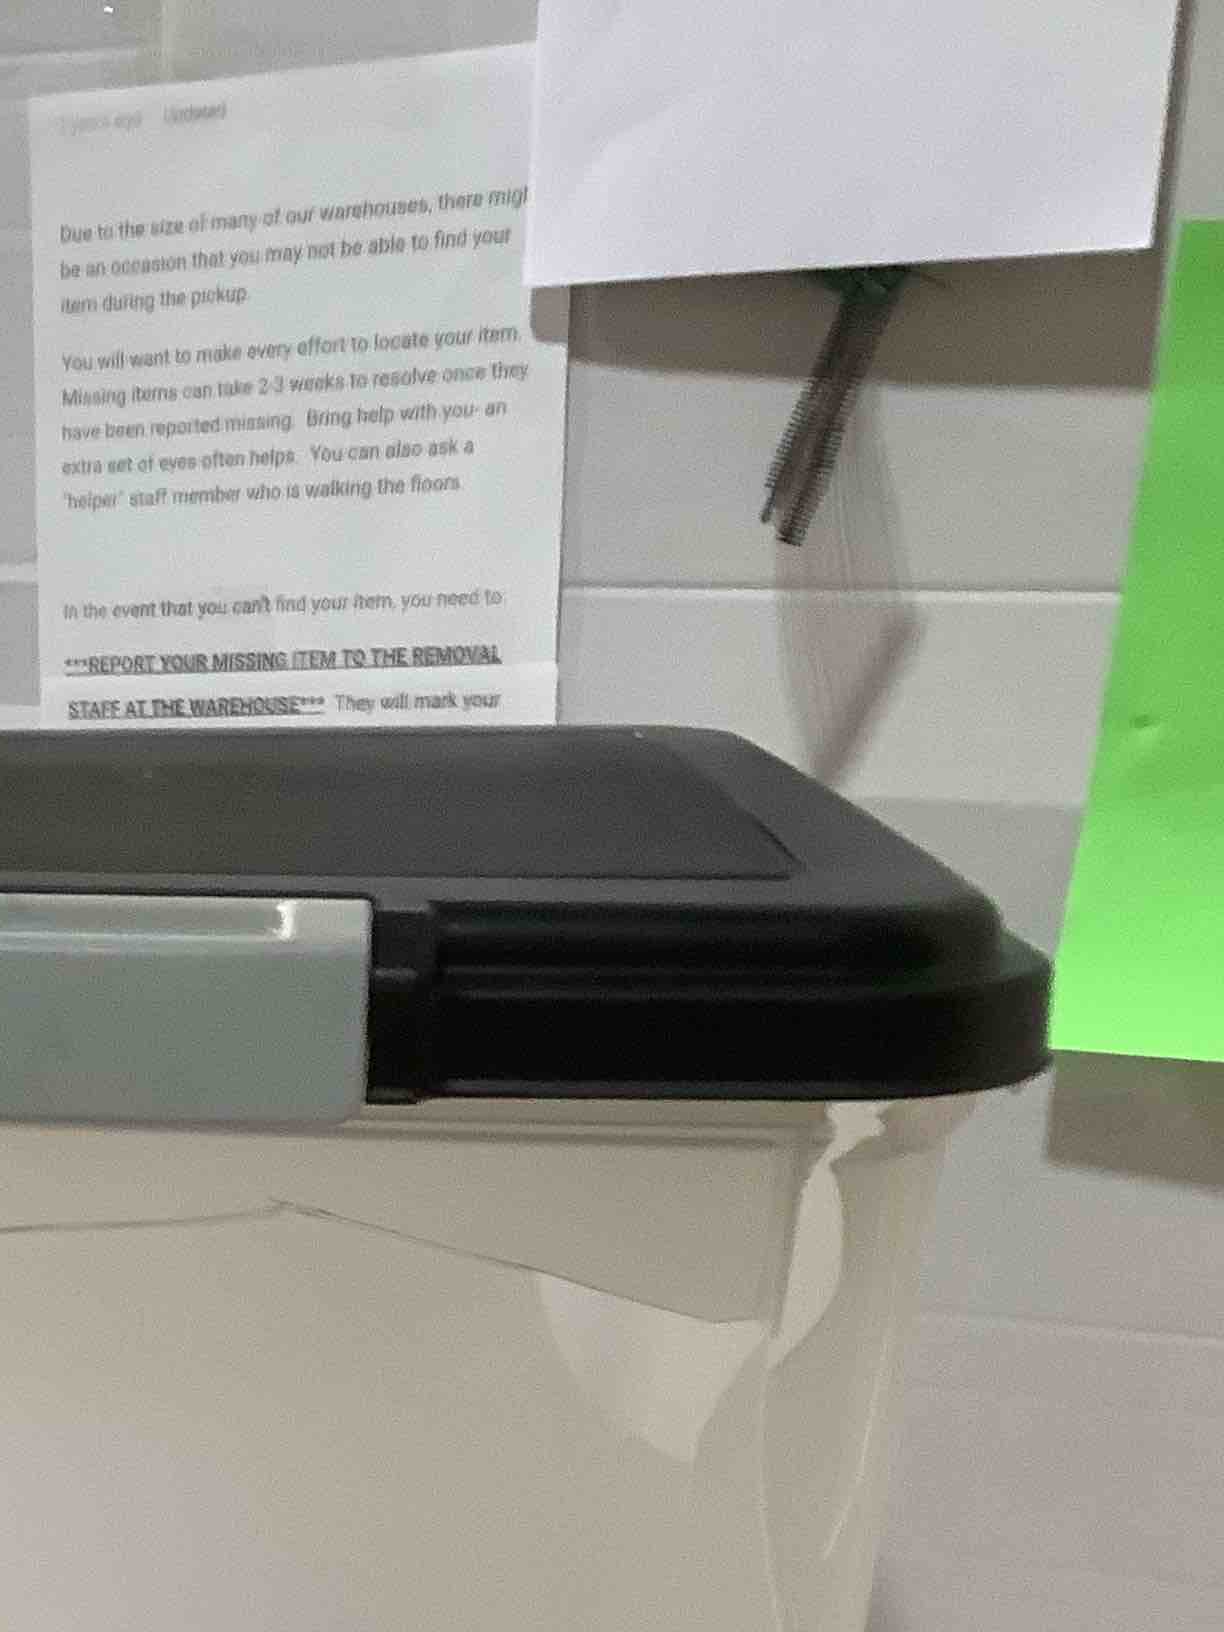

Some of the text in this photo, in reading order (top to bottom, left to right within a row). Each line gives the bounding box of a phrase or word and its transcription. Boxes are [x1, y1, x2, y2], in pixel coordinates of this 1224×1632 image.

[60, 223, 93, 243] Due
[97, 223, 114, 241] to
[118, 219, 146, 239] the
[150, 218, 184, 237] size
[189, 212, 207, 233] of
[211, 212, 258, 233] many
[263, 207, 282, 227] of
[286, 207, 315, 225] our
[319, 197, 433, 223] warehouses,
[437, 191, 484, 211] there
[60, 228, 512, 279] be an occasion that you may not be able to find your
[61, 295, 98, 315] item
[102, 292, 155, 315] during
[159, 289, 187, 309] the
[62, 352, 94, 372] You
[97, 350, 125, 370] will
[129, 348, 171, 369] want
[174, 347, 192, 366] to
[196, 343, 243, 364] make
[246, 341, 293, 363] every
[297, 334, 346, 357] effort
[351, 334, 369, 353] to
[374, 331, 430, 352] locate
[434, 329, 474, 351] your
[62, 360, 530, 408] Missing items can take 2-3 weeks to resolve once they
[61, 423, 101, 441] have
[104, 420, 146, 440] been
[150, 415, 221, 438] reported
[306, 407, 353, 430] Bring
[356, 404, 395, 427] help
[399, 402, 438, 423] with
[484, 401, 508, 418] an
[61, 457, 103, 477] extra
[107, 456, 134, 475] set
[137, 454, 155, 473] of
[158, 454, 198, 474] eyes
[201, 449, 246, 469] often
[310, 443, 344, 463] You
[347, 443, 381, 461] can
[384, 438, 423, 459] also
[427, 438, 459, 458] ask
[462, 439, 476, 456] a
[129, 486, 169, 507] staff
[172, 484, 242, 506] member
[246, 482, 282, 501] who
[286, 481, 301, 500] is
[305, 477, 374, 501] walking
[377, 476, 406, 496] the
[63, 602, 78, 620] In
[83, 601, 107, 619] the
[112, 602, 157, 619] event
[161, 599, 194, 618] that
[197, 600, 227, 621] you
[276, 592, 307, 613] find
[311, 592, 349, 615] your
[400, 591, 433, 613] you
[436, 586, 481, 608] need
[485, 587, 504, 606] to
[159, 653, 210, 674] YOUR
[212, 650, 288, 673] MISSING
[291, 648, 338, 669] ITEM
[341, 647, 367, 669] TO
[370, 646, 410, 667] THE
[412, 643, 504, 666] REMOVAL
[68, 699, 122, 721] STAFF
[125, 699, 149, 719] AT
[152, 698, 186, 719] THE
[335, 693, 377, 715] They
[380, 692, 410, 711] will
[414, 691, 458, 711] mark
[462, 692, 503, 714] your
